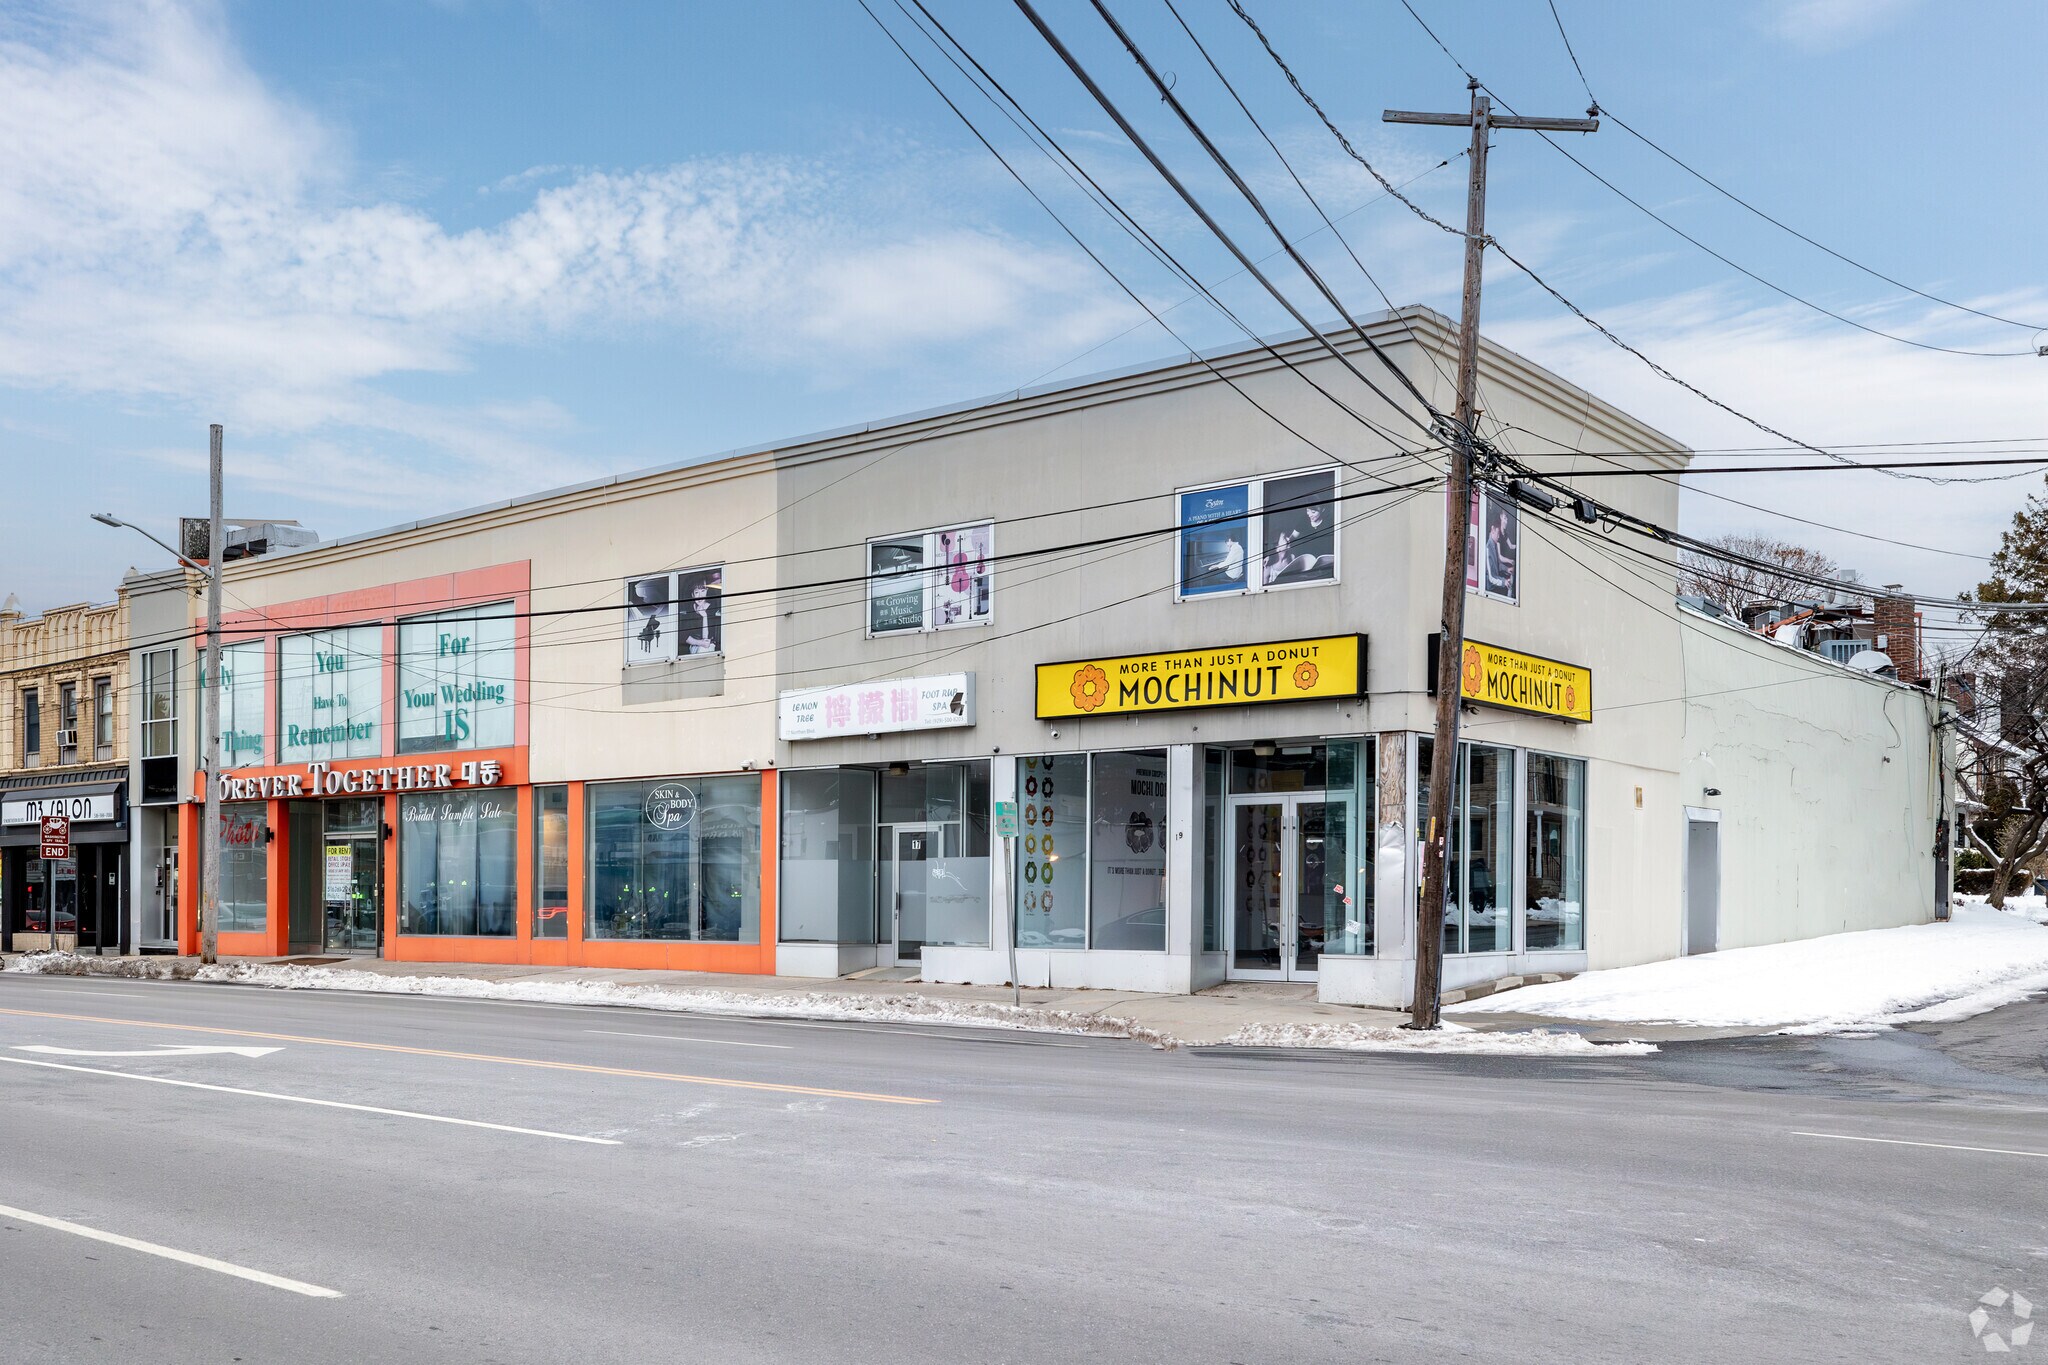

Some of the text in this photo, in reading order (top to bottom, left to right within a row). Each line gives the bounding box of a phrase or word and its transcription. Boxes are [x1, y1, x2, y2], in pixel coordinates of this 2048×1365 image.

[886, 594, 919, 606] Growing
[891, 605, 913, 616] Music
[898, 613, 922, 625] Studio
[440, 633, 470, 656] For
[316, 651, 343, 672] You
[1119, 646, 1319, 675] MORE THAN JUST A DONUT
[1487, 653, 1576, 682] MORE THAN JUST A DONUT
[201, 665, 232, 691] ly
[1119, 665, 1282, 706] MOCHINUT
[404, 681, 504, 708] Your Wedding
[921, 690, 940, 700] FOOT
[1487, 668, 1561, 711] MOCHINUT
[314, 693, 347, 709] Have To
[792, 702, 818, 712] LEMON
[932, 702, 947, 711] SPA
[443, 708, 469, 742] IS
[796, 714, 814, 723] TREE
[222, 730, 262, 755] Thing
[288, 719, 372, 747] Remember
[219, 762, 453, 800] OREVER TOGETHER
[461, 760, 502, 786] 대동
[654, 789, 680, 799] SKIN &
[1130, 780, 1153, 796] MOCHI
[26, 797, 92, 821] M3 SALON
[405, 801, 502, 826] Bridal Sample Sale
[653, 801, 682, 828] Spa
[670, 798, 693, 809] BODY
[1175, 831, 1183, 841] 19
[45, 847, 64, 856] END
[328, 847, 351, 855] FOR RENT
